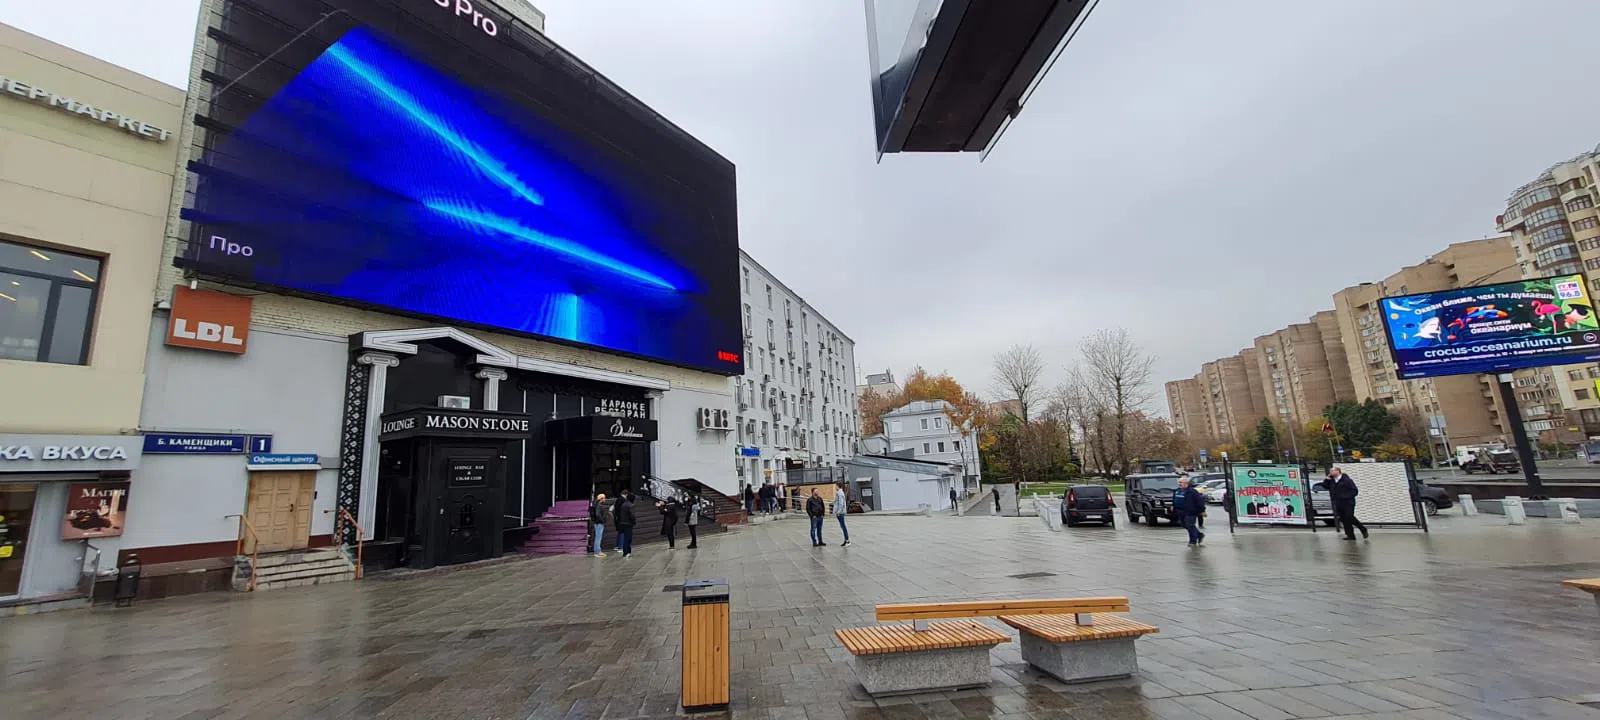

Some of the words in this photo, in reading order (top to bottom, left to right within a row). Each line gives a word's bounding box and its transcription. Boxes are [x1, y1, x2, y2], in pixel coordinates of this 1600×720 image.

[209, 235, 254, 257] Про
[1414, 302, 1443, 316] Океан
[173, 318, 243, 345] LBL
[1470, 322, 1532, 334] океанариум
[1424, 335, 1572, 358] crocus-oceanarium.ru
[601, 398, 646, 411] КАРАОКЕ
[383, 417, 415, 433] LOUNGE
[426, 415, 479, 430] MASON
[482, 418, 529, 431] ST.ONE
[158, 438, 167, 446] Б.
[169, 438, 233, 447] КАМЕНЩИКИ
[258, 439, 265, 451] 1
[42, 445, 128, 460] ВКУСА
